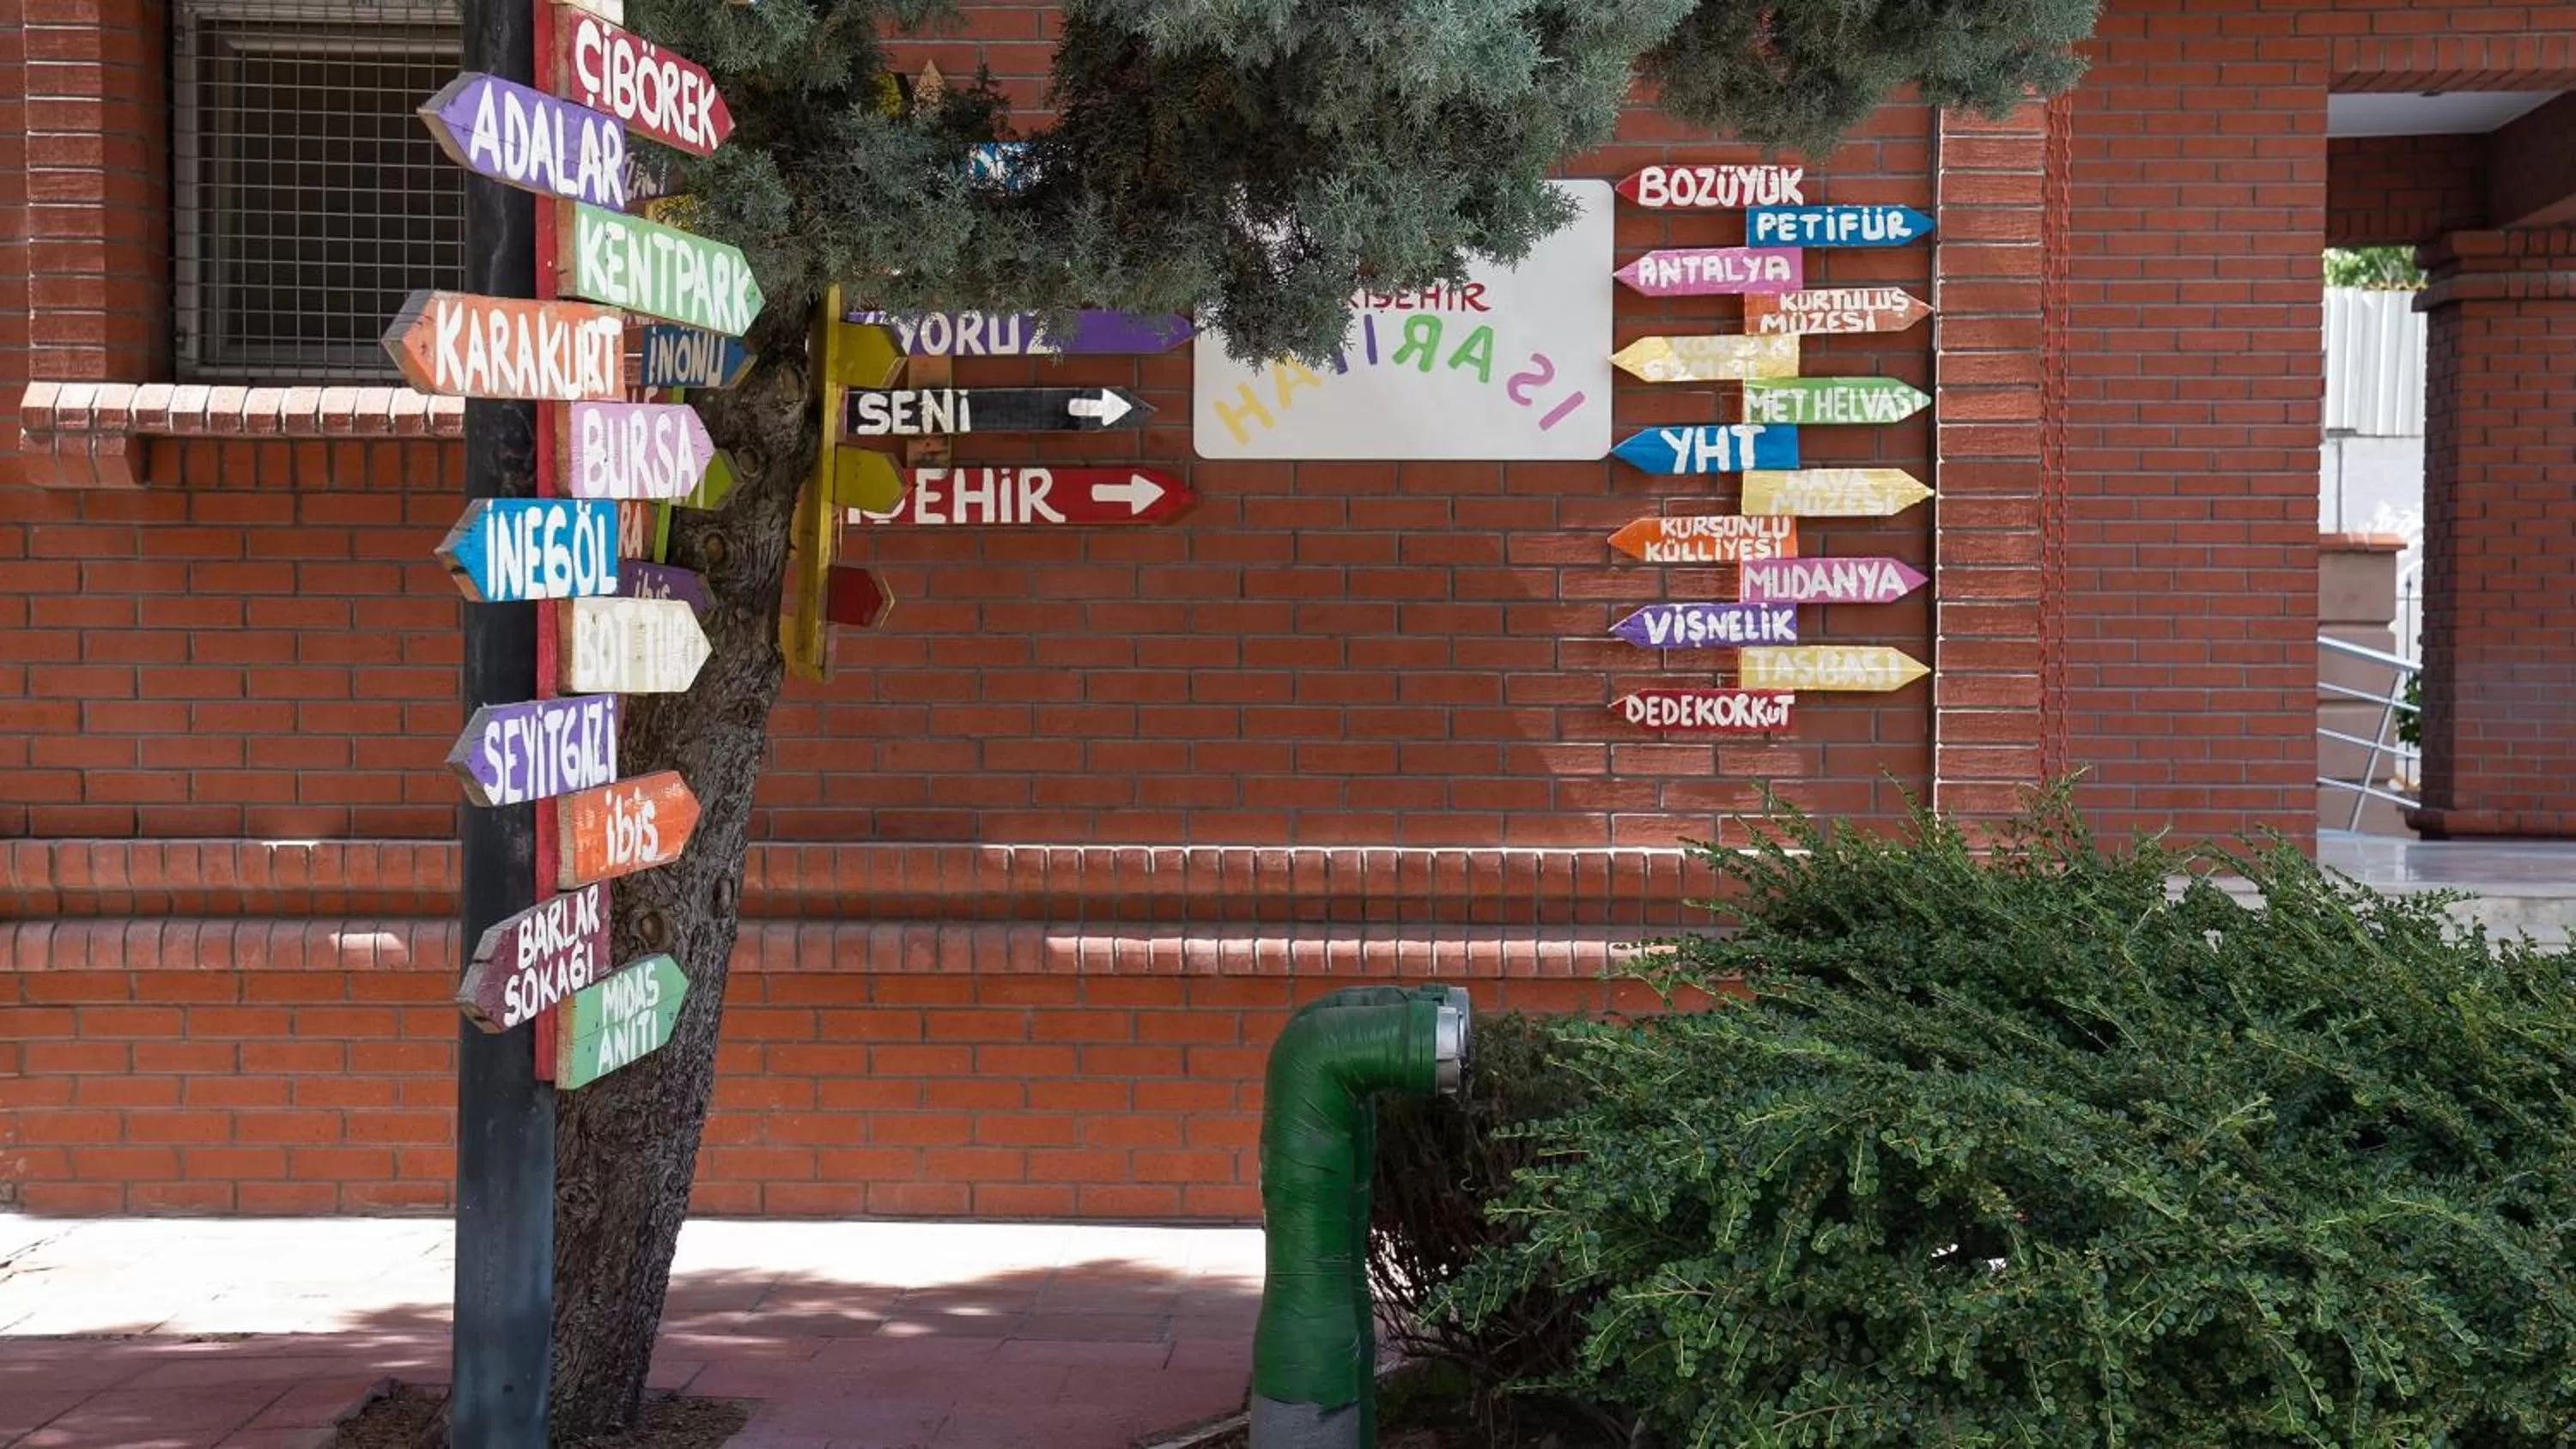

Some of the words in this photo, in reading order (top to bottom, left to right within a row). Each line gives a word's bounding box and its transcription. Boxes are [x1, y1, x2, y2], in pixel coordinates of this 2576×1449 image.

[575, 19, 719, 149] ÇİBÖREK
[470, 82, 625, 209] ADALAR
[1637, 166, 1804, 206] BOZÜYÜK
[1757, 208, 1911, 241] PETİFÜR
[580, 213, 751, 335] KENTPARK
[1638, 256, 1790, 287] ANTALYA
[435, 300, 623, 400] KARAKURT
[857, 388, 971, 435] SENİ
[1745, 387, 1808, 423] MET
[582, 408, 698, 498] BURSA
[1660, 424, 1765, 473] YHT
[487, 499, 617, 602] İNEGÖL
[1744, 563, 1907, 599] MUDANYA
[518, 884, 600, 970] BARLAR
[603, 962, 659, 1027] MİDAS
[598, 1010, 658, 1076] ANITI
